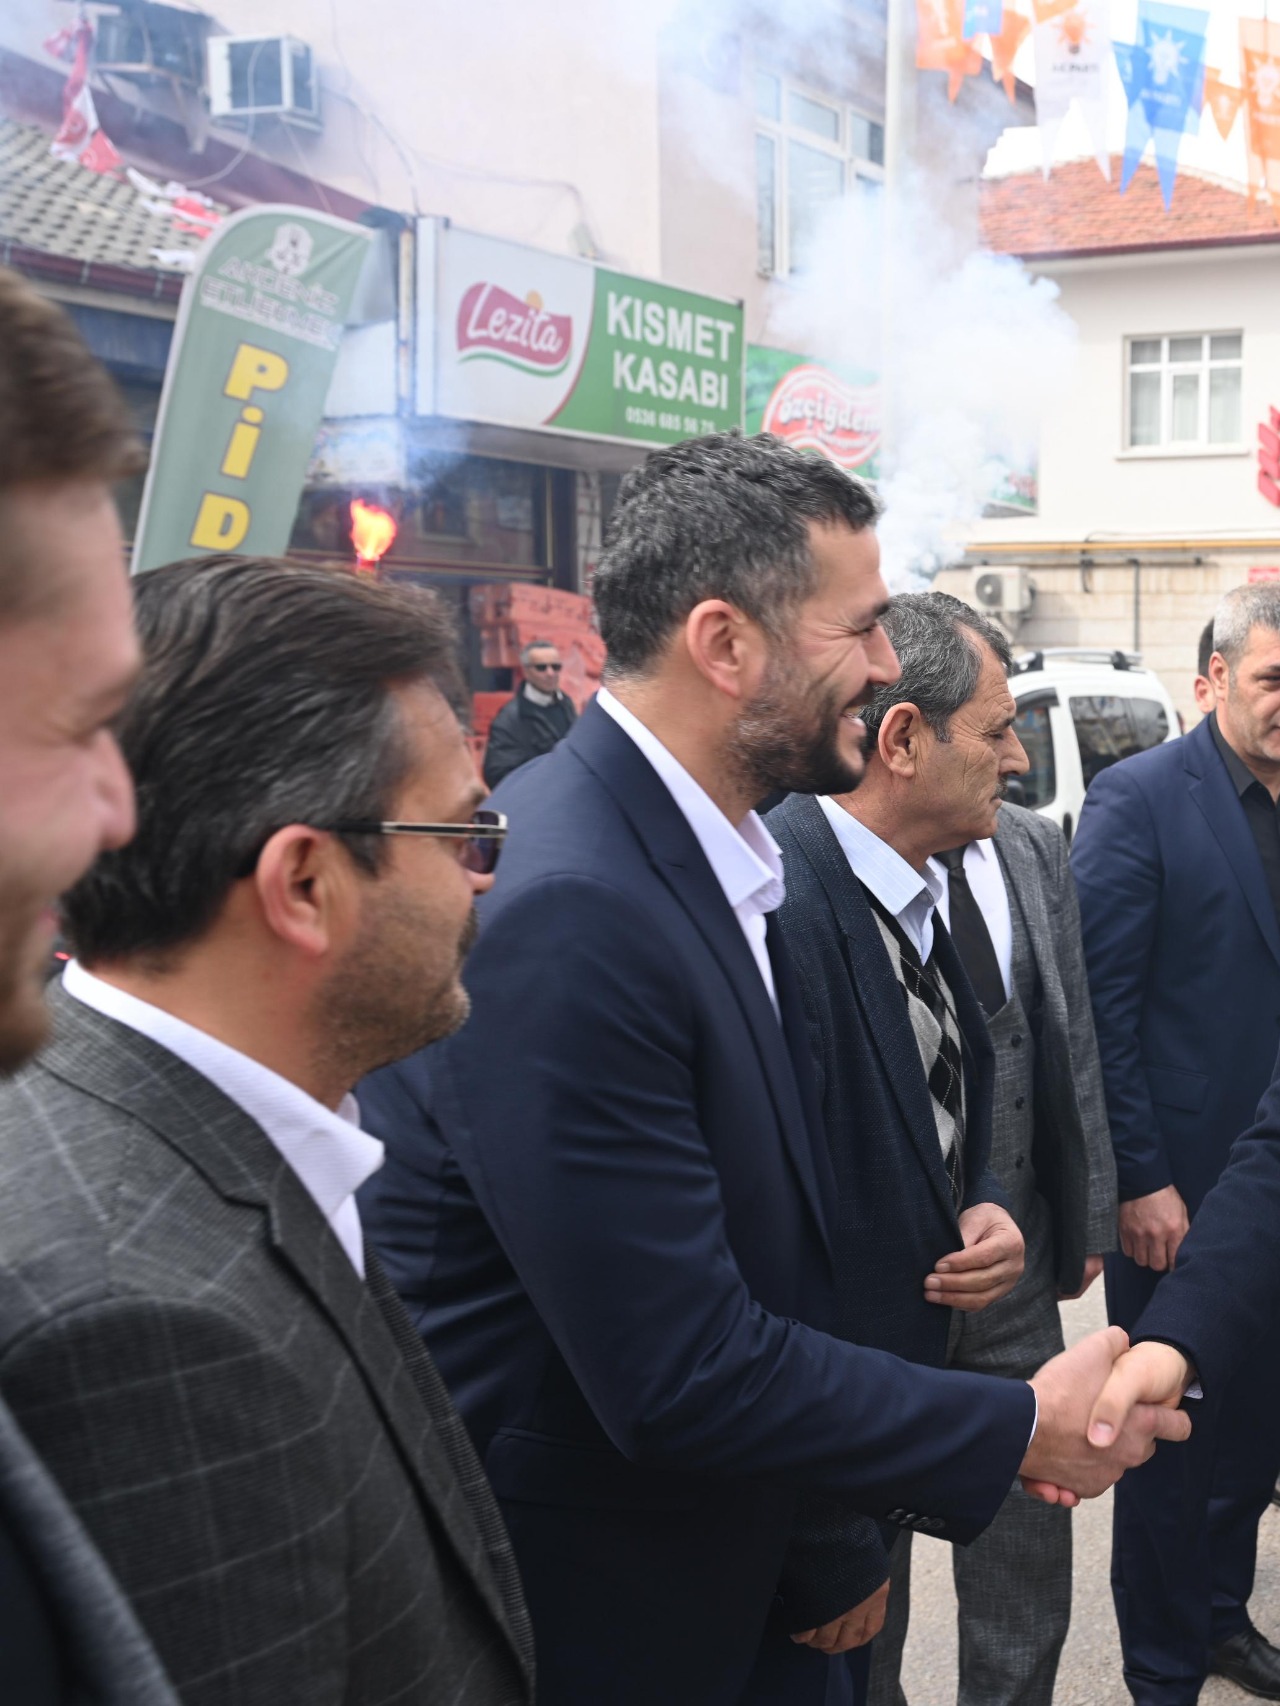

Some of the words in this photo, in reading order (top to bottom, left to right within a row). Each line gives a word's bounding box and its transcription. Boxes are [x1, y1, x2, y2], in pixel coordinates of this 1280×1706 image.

[466, 283, 563, 353] Lezita
[606, 291, 736, 362] KISMET
[612, 349, 729, 411] KASABI
